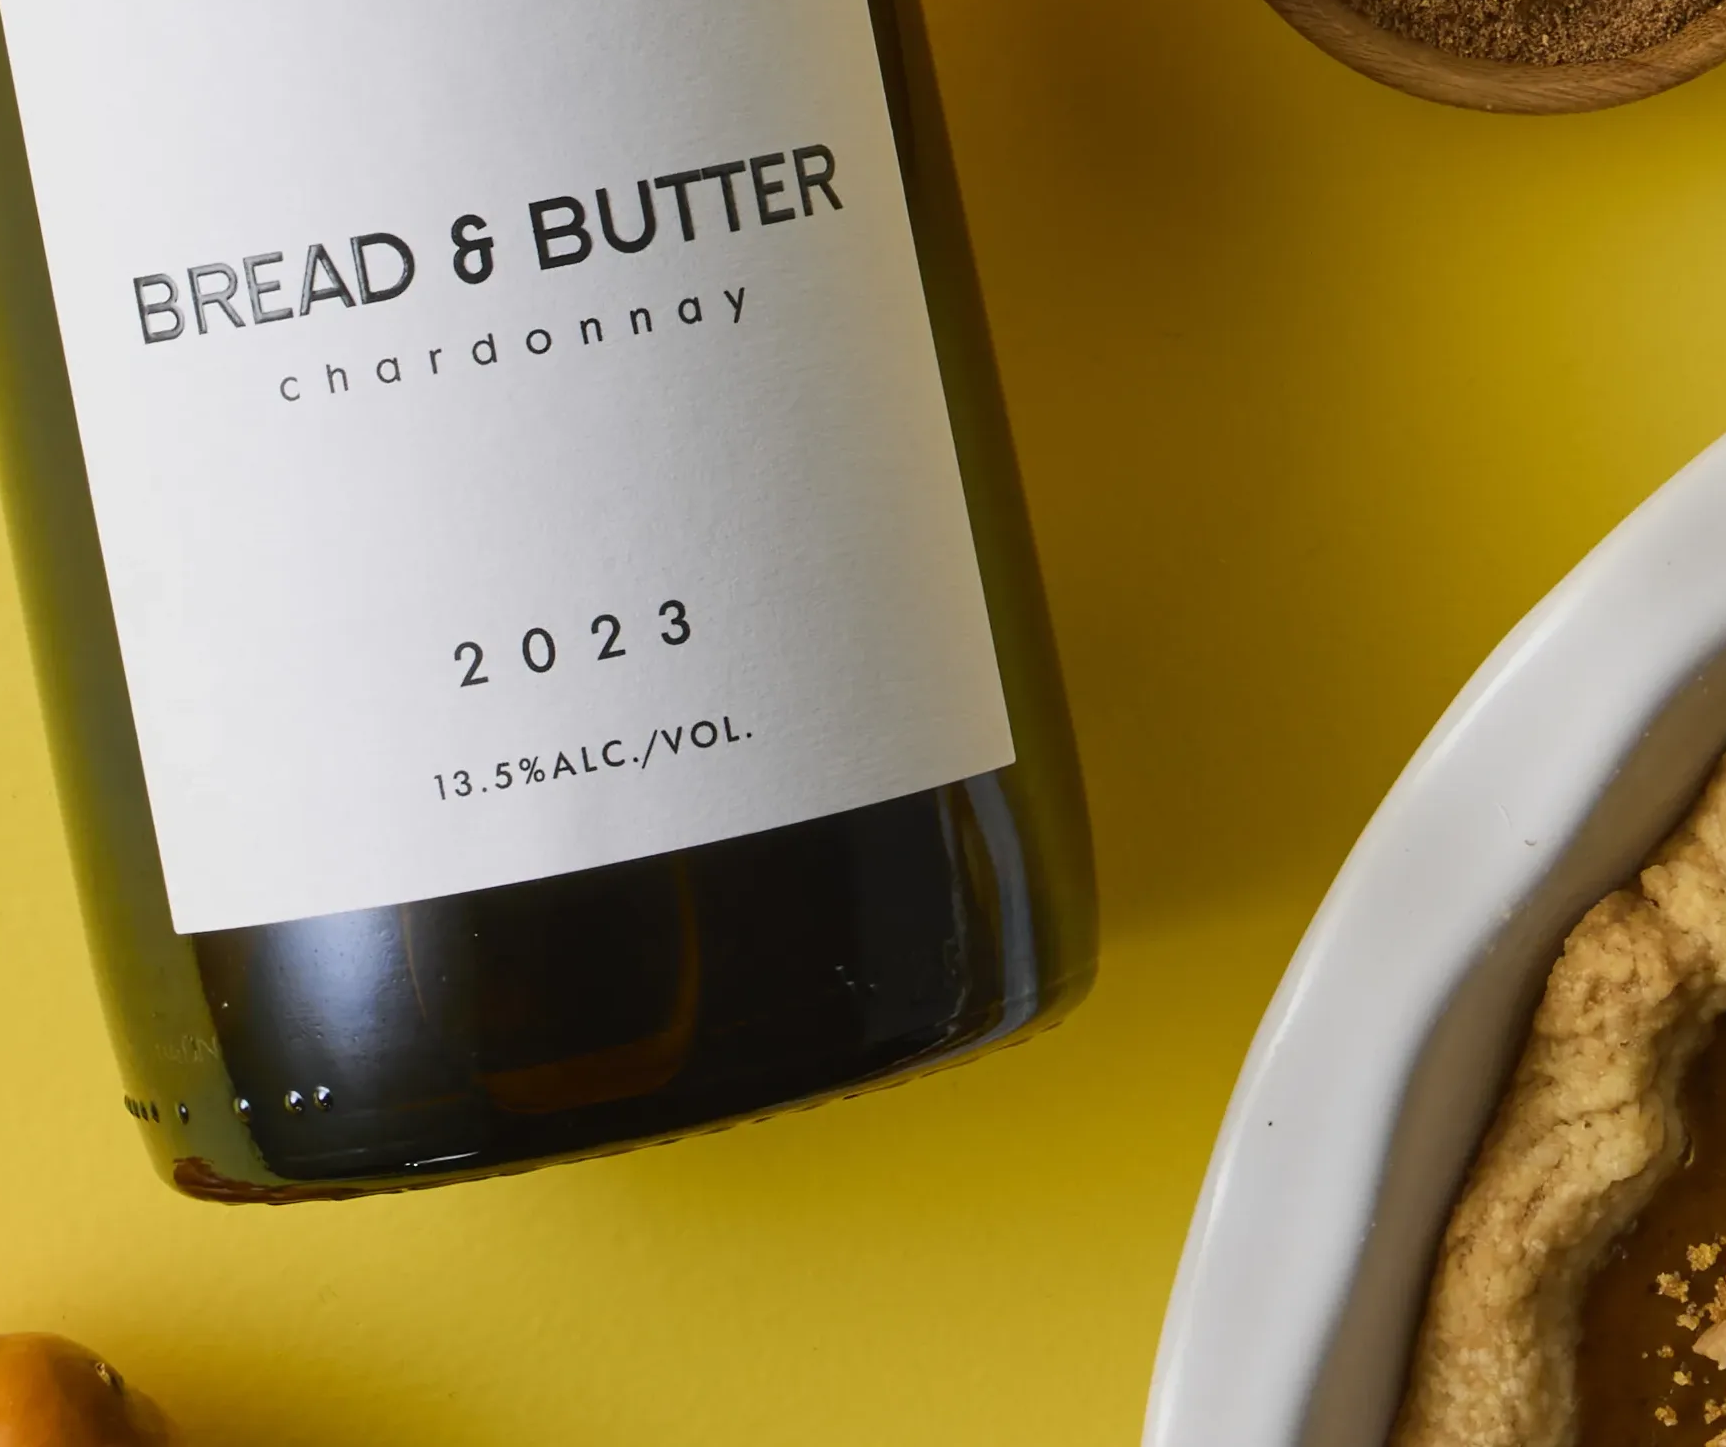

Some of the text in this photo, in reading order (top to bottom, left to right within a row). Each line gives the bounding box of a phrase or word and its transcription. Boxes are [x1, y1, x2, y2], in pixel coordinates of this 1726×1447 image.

[131, 142, 845, 347] BREAD & BUTTER
[278, 283, 748, 403] chardonnay
[452, 598, 693, 689] 2023
